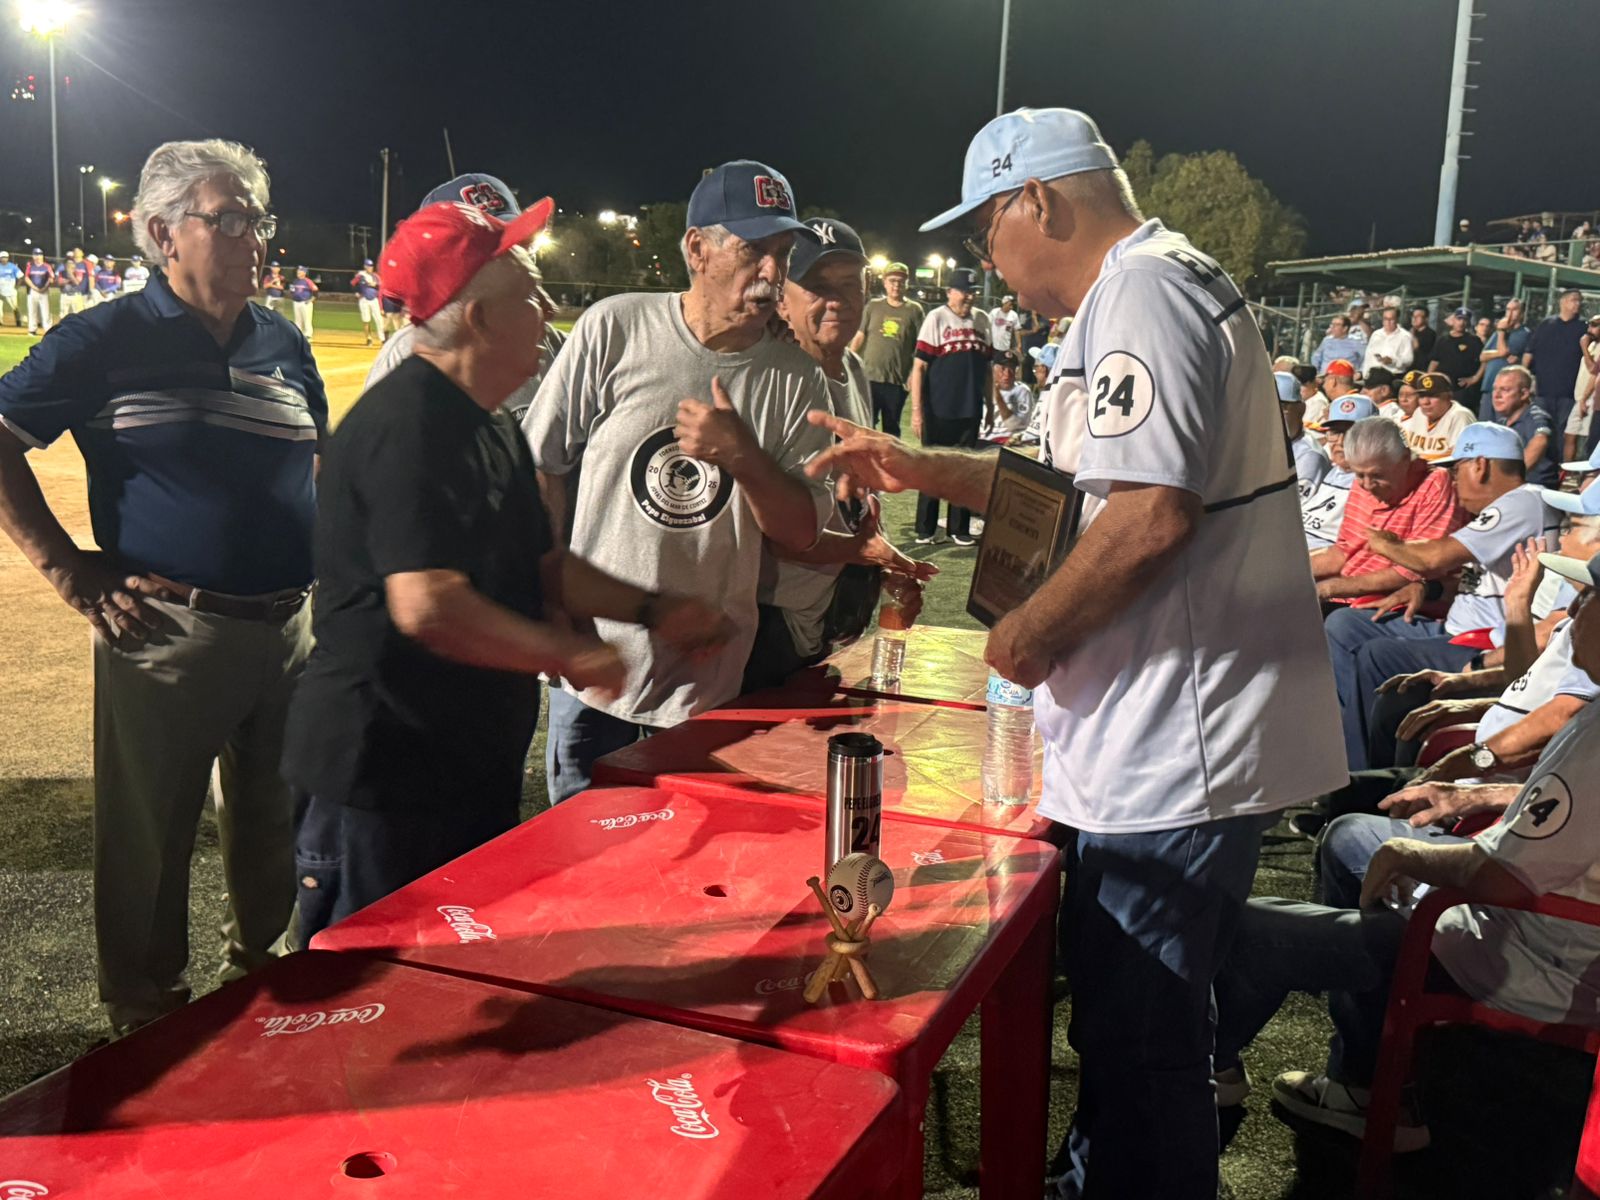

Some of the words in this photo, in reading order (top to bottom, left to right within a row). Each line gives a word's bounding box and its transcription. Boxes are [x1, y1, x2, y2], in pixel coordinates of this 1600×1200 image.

[992, 153, 1012, 177] 24
[813, 222, 836, 245] NY
[1094, 374, 1135, 419] 24
[648, 465, 659, 474] 20
[708, 481, 717, 489] 25
[641, 499, 660, 518] Pepe
[591, 808, 675, 831] Coca-Cola
[851, 812, 881, 853] 24
[256, 1002, 386, 1037] Coca-Cola
[645, 1072, 720, 1139] Coca-Cola
